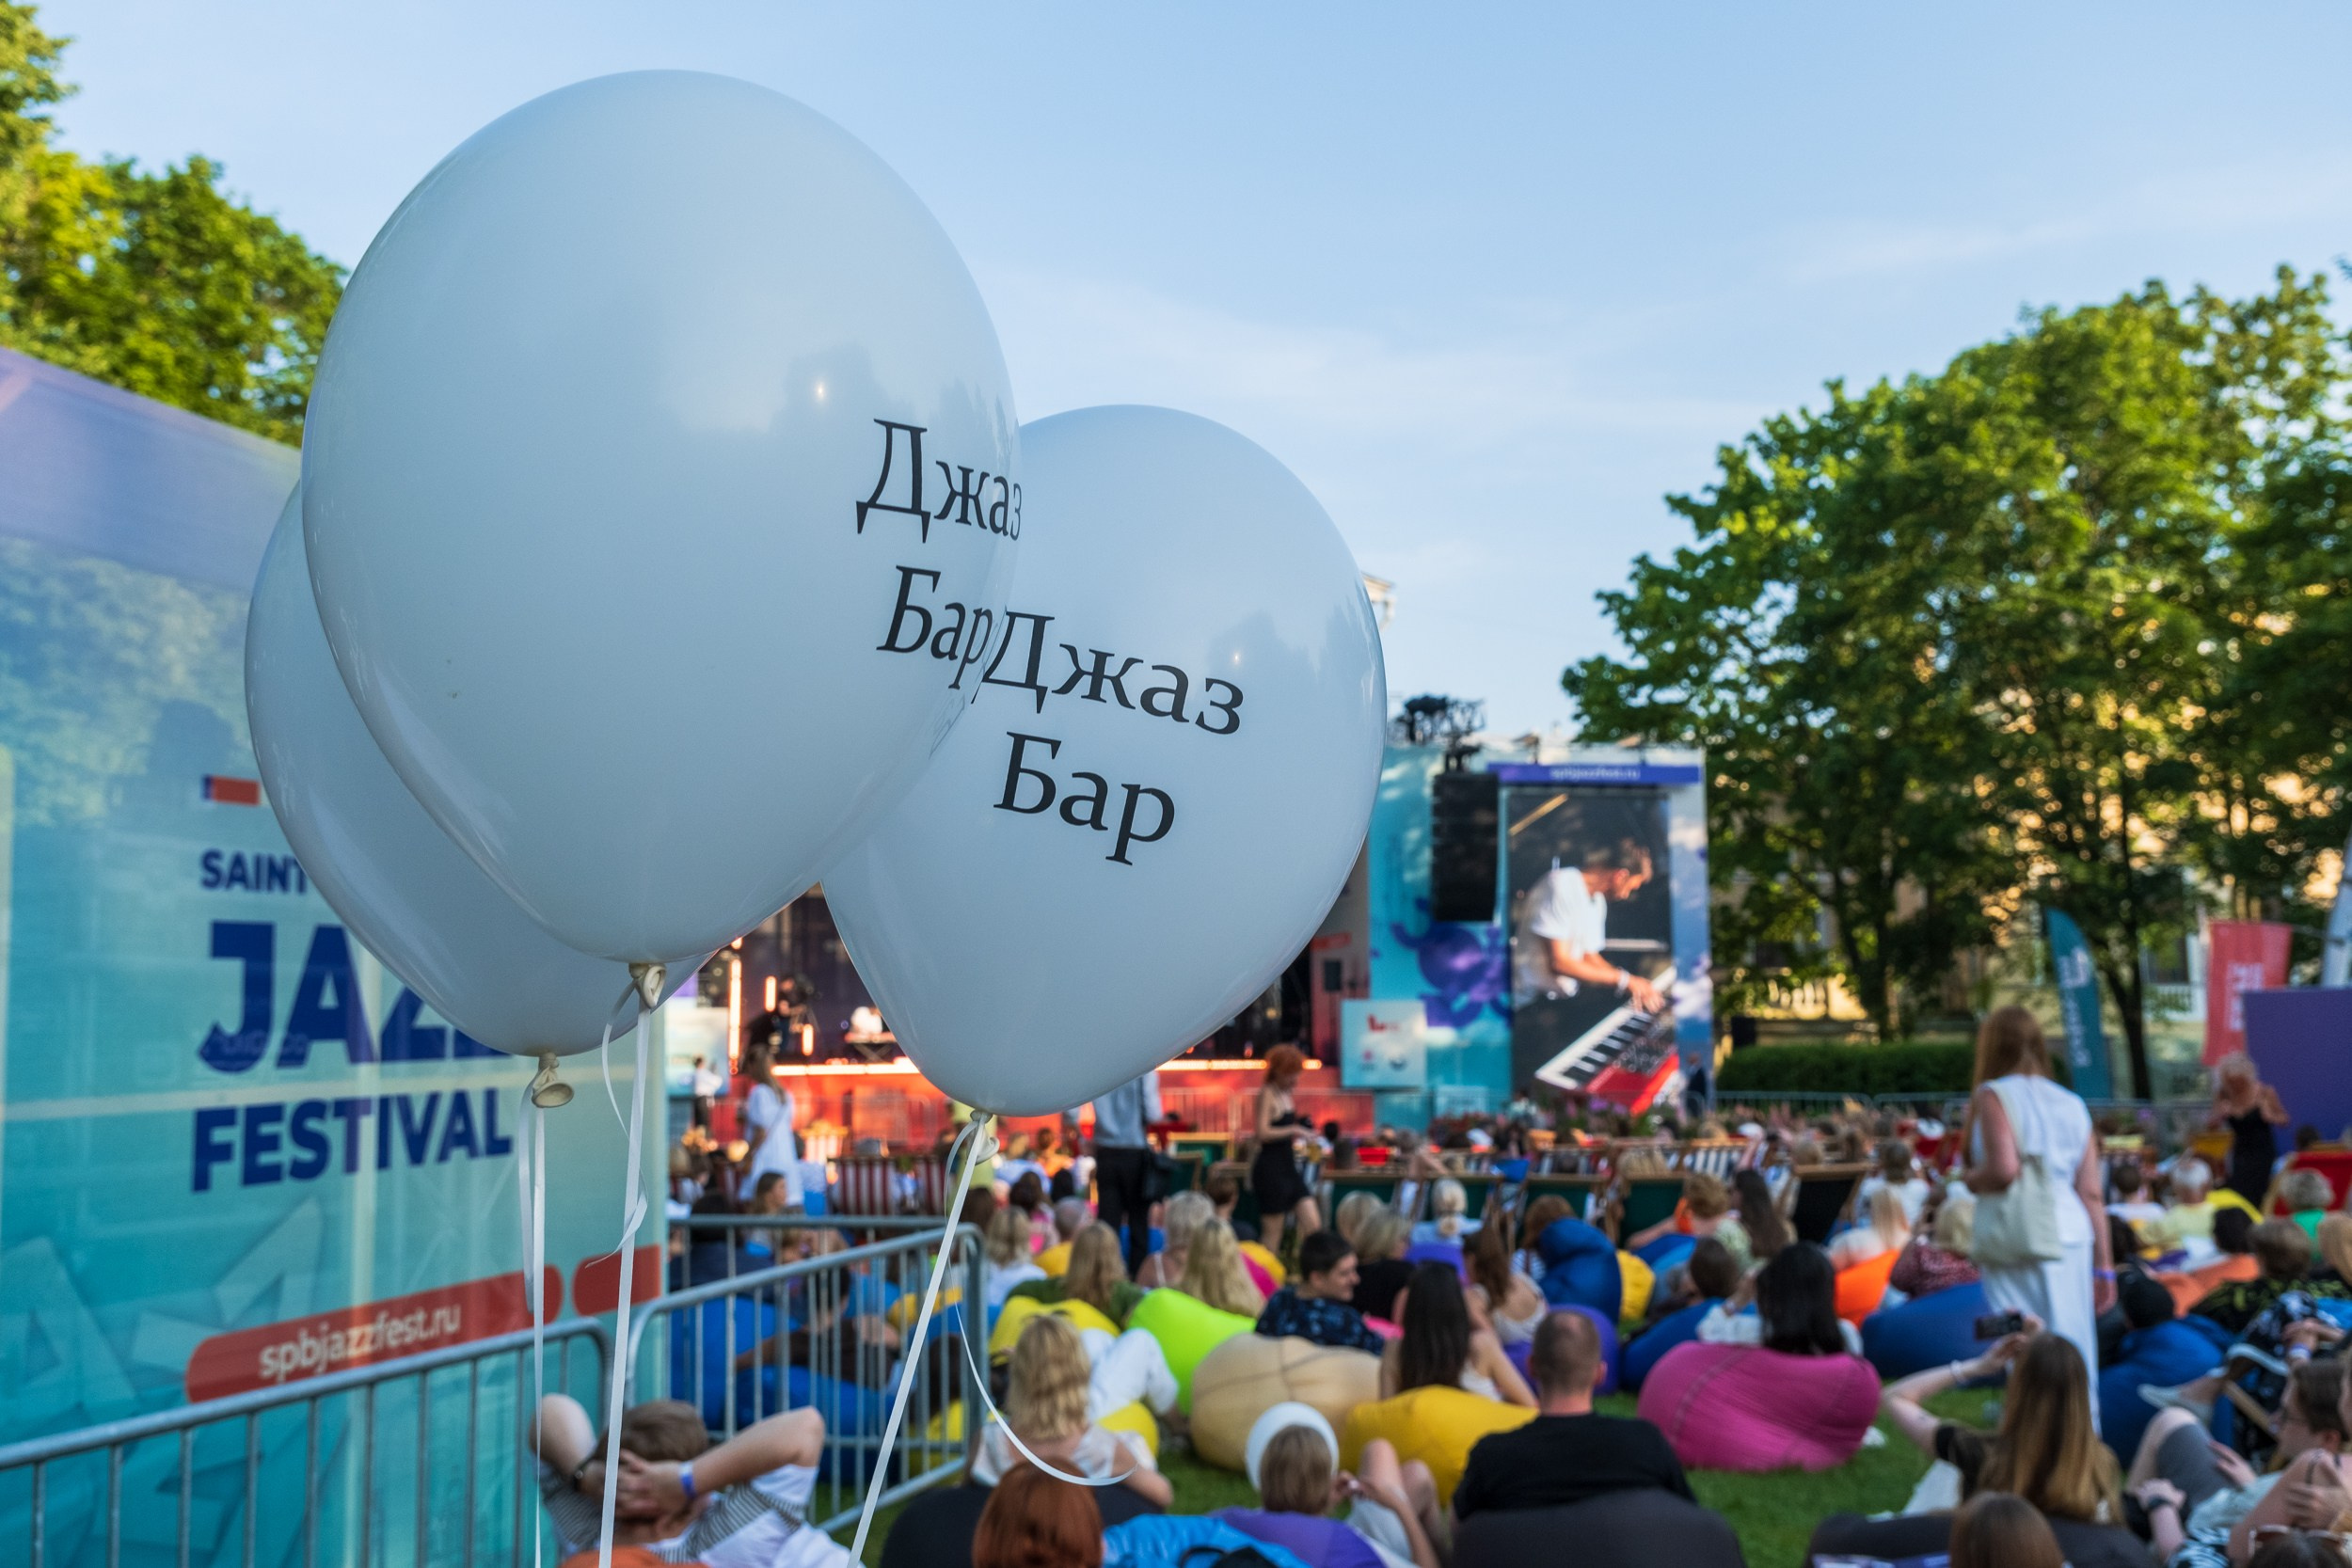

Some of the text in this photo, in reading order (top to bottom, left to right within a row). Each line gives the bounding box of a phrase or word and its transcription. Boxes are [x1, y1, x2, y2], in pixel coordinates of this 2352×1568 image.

[856, 419, 1023, 544] Джаз
[876, 564, 993, 689] Бар
[971, 610, 1244, 736] Джаз
[993, 731, 1175, 865] Бар
[199, 919, 513, 1073] JAZ
[192, 1087, 514, 1194] FESTIVAL
[259, 1304, 461, 1384] spbjazzfest.ru
